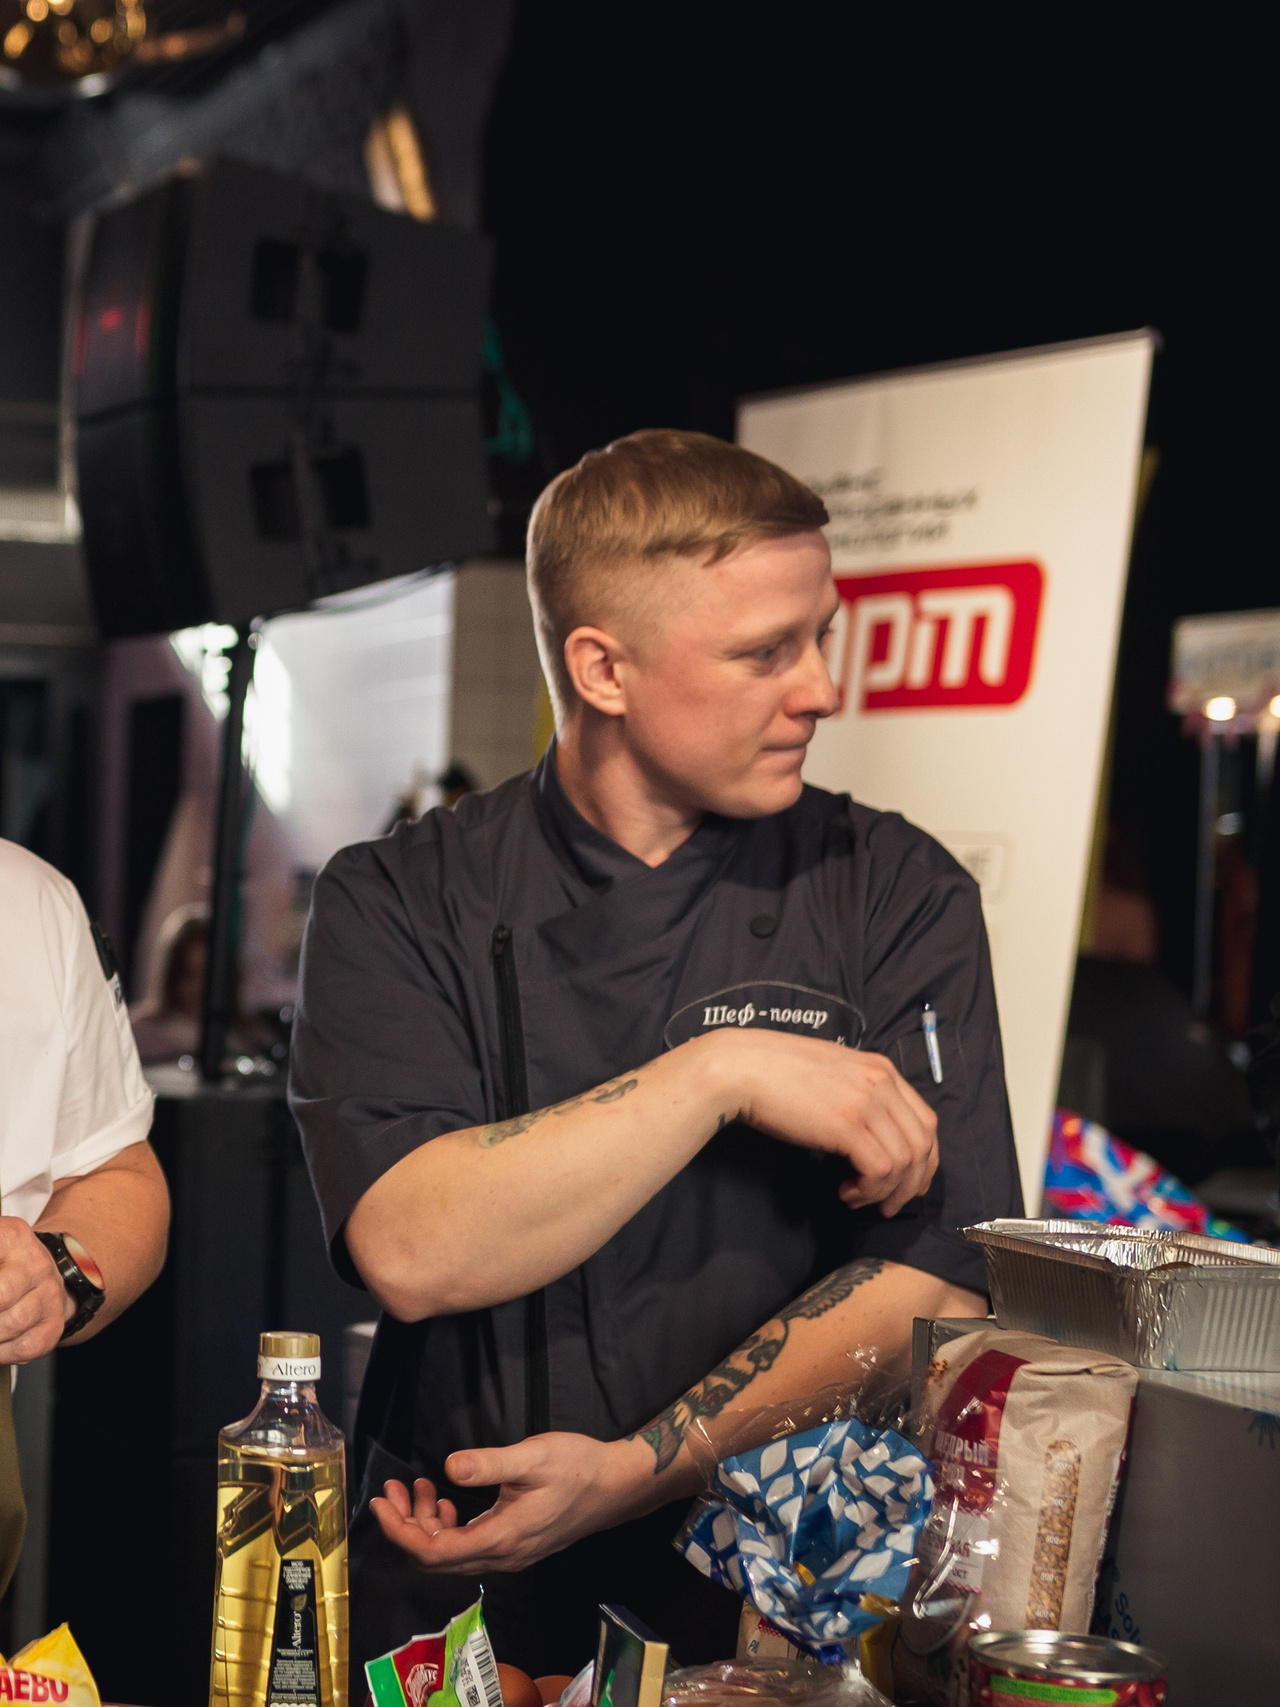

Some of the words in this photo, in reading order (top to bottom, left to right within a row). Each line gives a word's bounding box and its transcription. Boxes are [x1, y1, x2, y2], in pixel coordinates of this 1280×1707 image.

[702, 1002, 829, 1029] Шеф-повар
[272, 1362, 317, 1376] Altero
[291, 1612, 302, 1651] Altero
